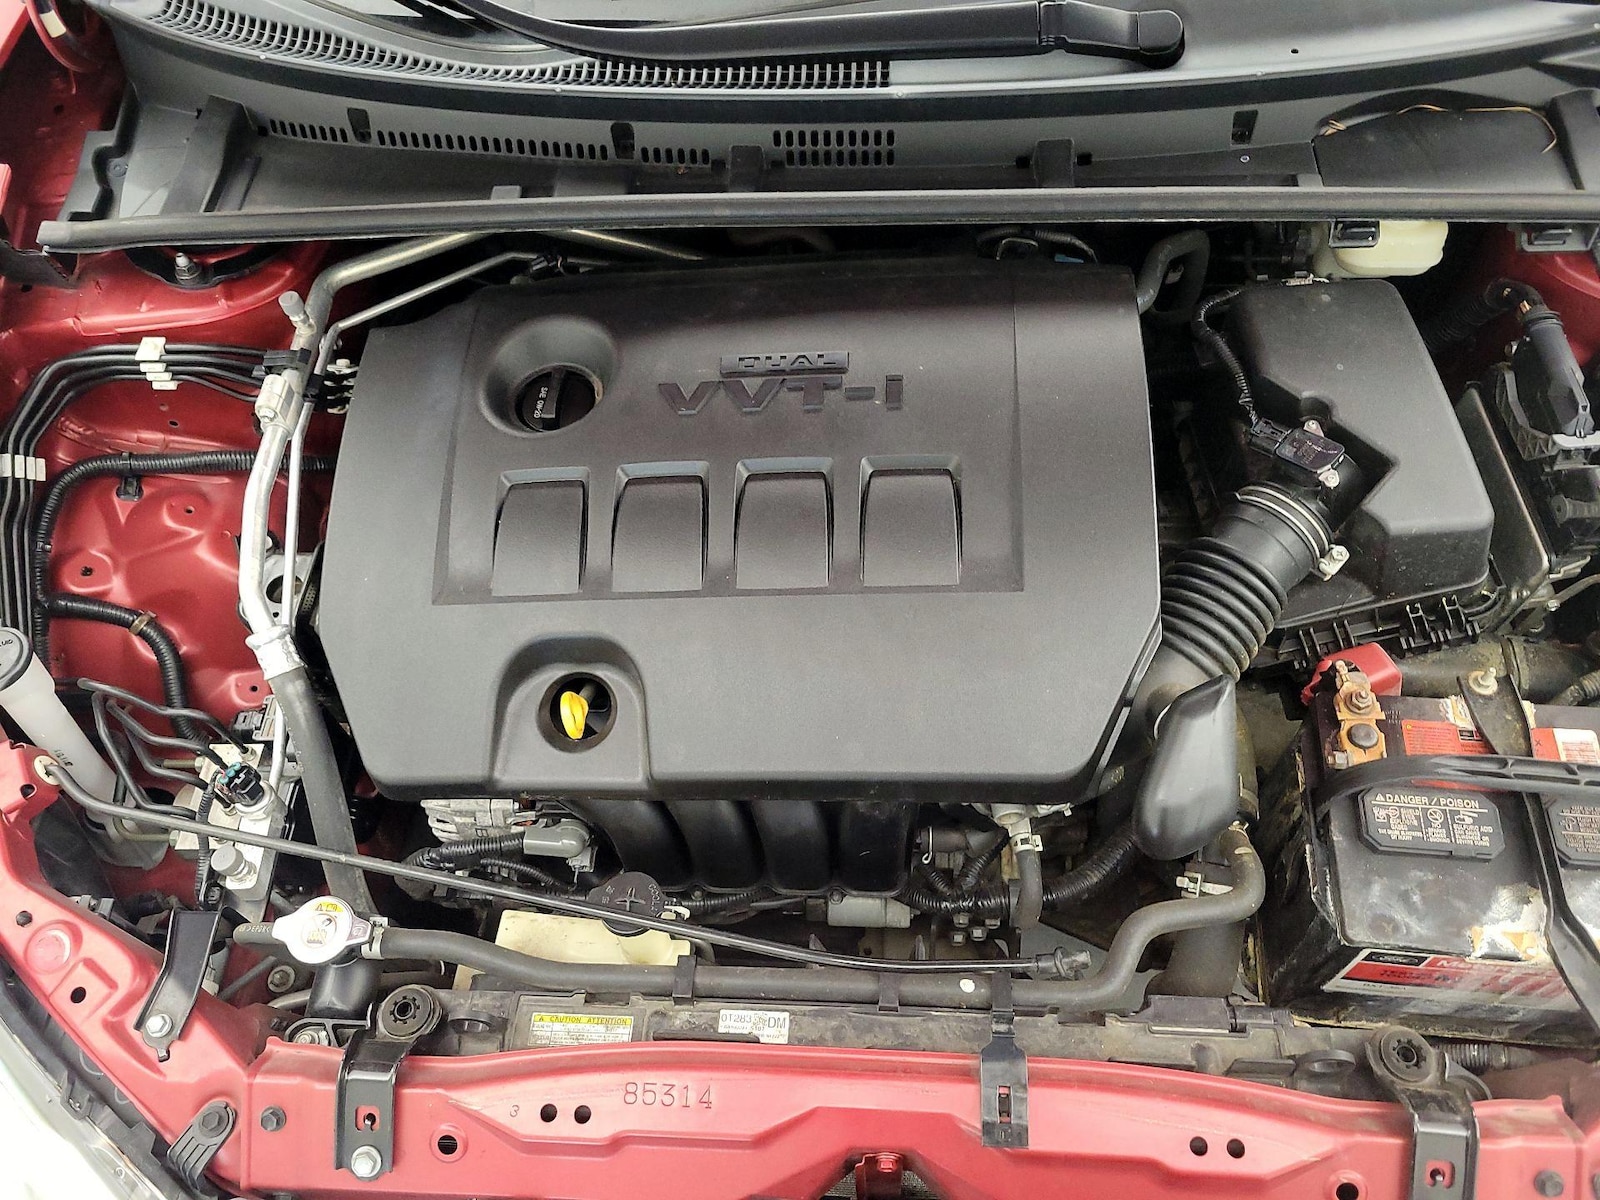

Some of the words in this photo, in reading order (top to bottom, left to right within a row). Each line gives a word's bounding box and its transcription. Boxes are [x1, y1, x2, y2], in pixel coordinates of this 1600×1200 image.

[738, 353, 837, 369] DUAL
[538, 386, 549, 399] SAE
[1385, 794, 1428, 805] DANGER
[1440, 798, 1479, 809] POISON
[550, 1016, 581, 1024] CAUTION
[587, 1017, 628, 1026] ATTENTION
[767, 1017, 786, 1029] DM
[623, 1082, 712, 1109] 85314
[509, 1104, 520, 1118] 3
